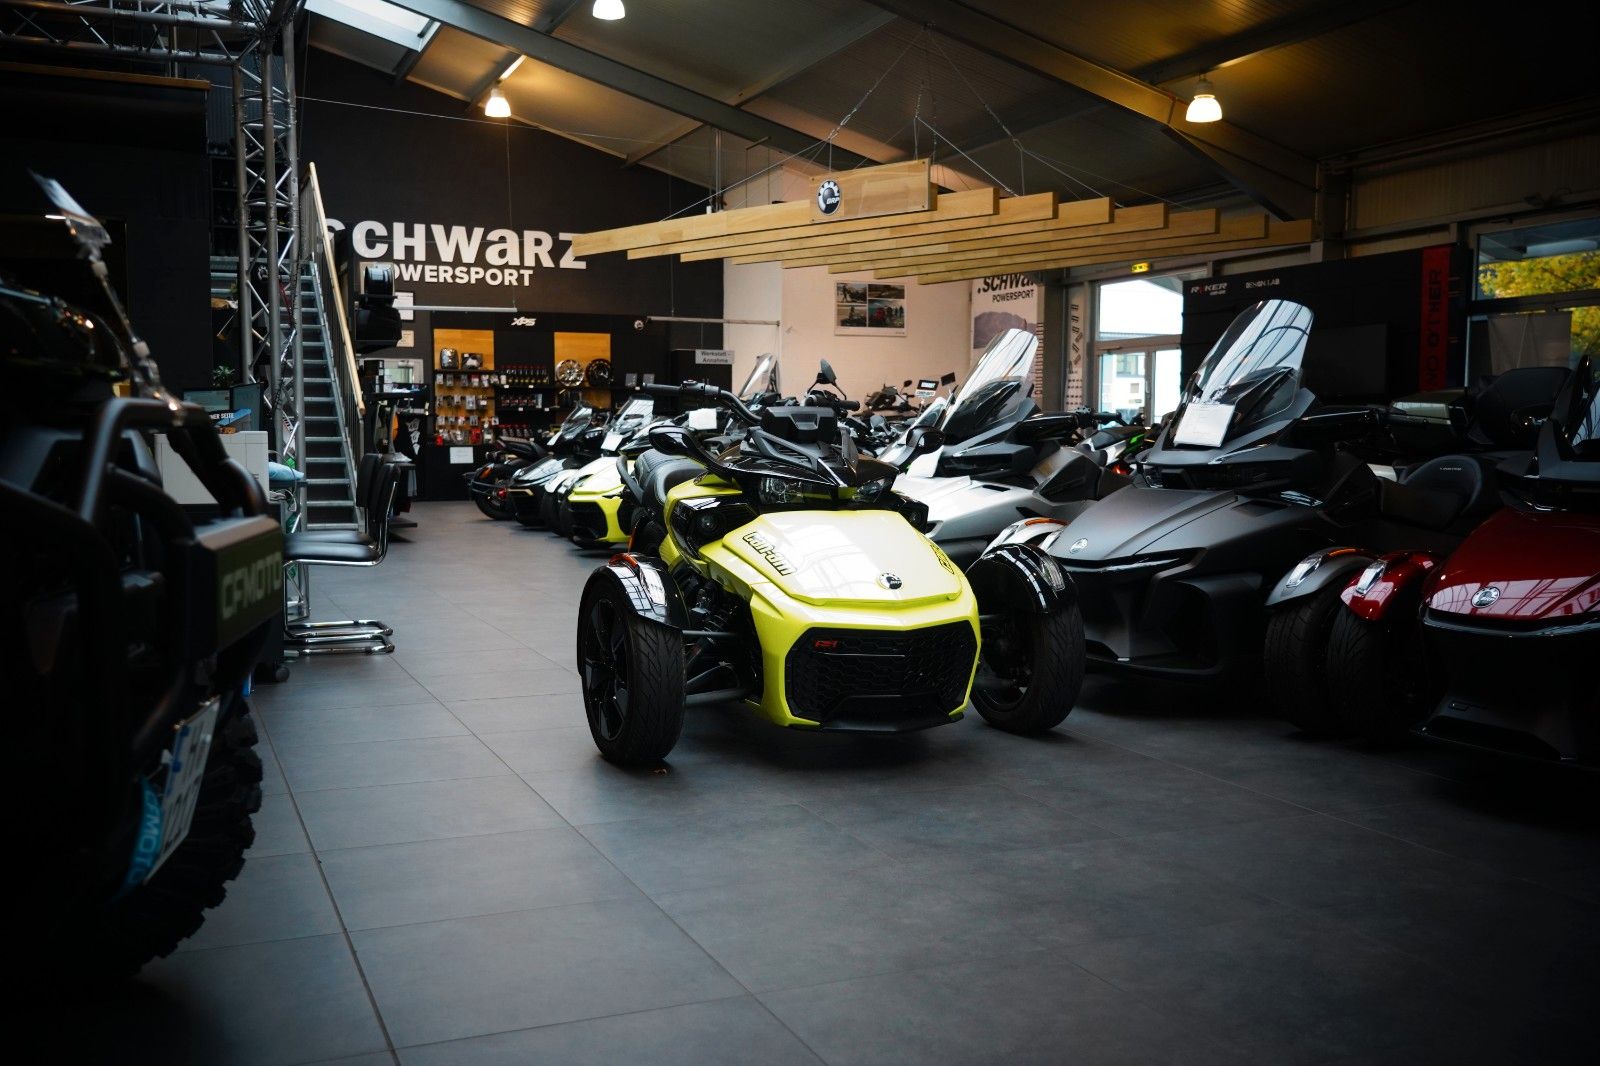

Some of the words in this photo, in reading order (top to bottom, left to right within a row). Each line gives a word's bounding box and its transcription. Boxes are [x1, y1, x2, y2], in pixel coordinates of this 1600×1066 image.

[394, 263, 533, 287] WERSPORT
[992, 289, 1034, 303] POWERSPORT
[221, 551, 283, 619] CFMOTO
